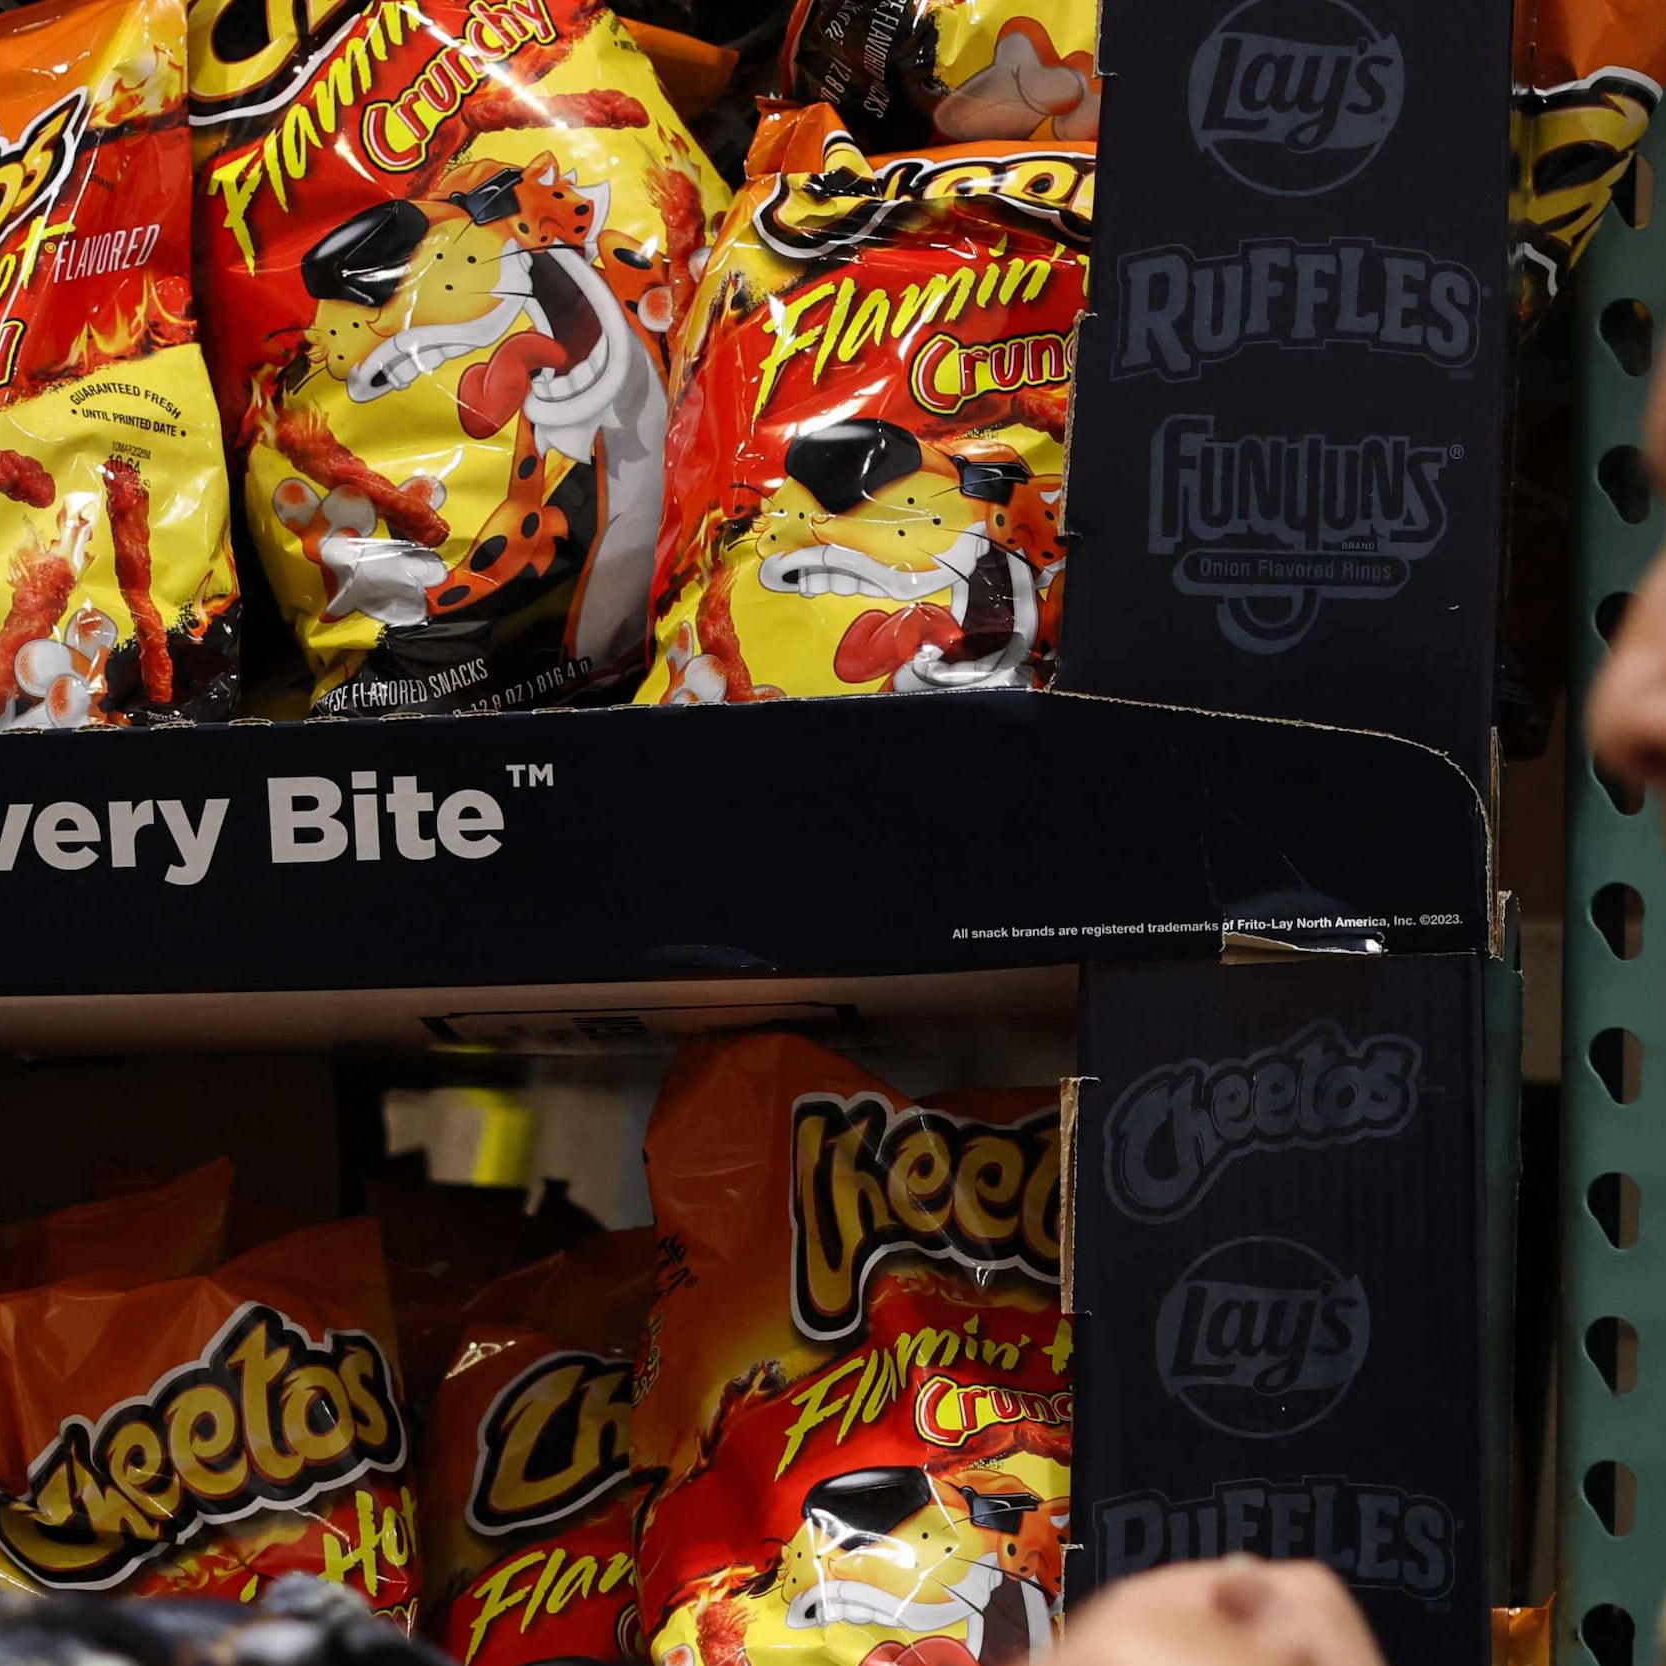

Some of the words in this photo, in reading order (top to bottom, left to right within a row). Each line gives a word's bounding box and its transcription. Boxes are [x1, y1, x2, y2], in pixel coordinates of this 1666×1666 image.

[362, 0, 559, 174] Crunchy
[1201, 36, 1393, 145] Lay's
[53, 223, 160, 285] FLAVORED
[1118, 240, 1481, 375] RUFFLES
[754, 230, 1065, 436] Flamin'
[70, 382, 141, 406] GUARANTEED
[144, 389, 181, 419] FRESH
[82, 408, 111, 422] UNTIL
[113, 412, 151, 430] PRINTED
[153, 421, 177, 437] DATE
[1149, 414, 1449, 556] FUNYUNS
[1198, 556, 1253, 579] Onion
[1257, 556, 1335, 580] Flavored
[1341, 559, 1393, 583] Rings
[352, 679, 429, 709] FLAVORED
[427, 657, 490, 698] SNACKS
[952, 928, 969, 940] All
[971, 926, 1009, 939] snack
[1012, 925, 1055, 939] brands
[1058, 926, 1079, 938] are
[1081, 922, 1145, 938] registered
[1147, 920, 1220, 934] trademarks
[1222, 919, 1235, 932] of
[1237, 918, 1294, 933] Frito-Lay
[1296, 916, 1332, 930] North
[1334, 915, 1391, 930] America,
[1393, 914, 1418, 928] Inc.
[1419, 913, 1463, 927] ©2023.
[1105, 1022, 1419, 1220] Cheetos
[1171, 1282, 1353, 1395] Lay's
[773, 1313, 1032, 1485] Flamin'
